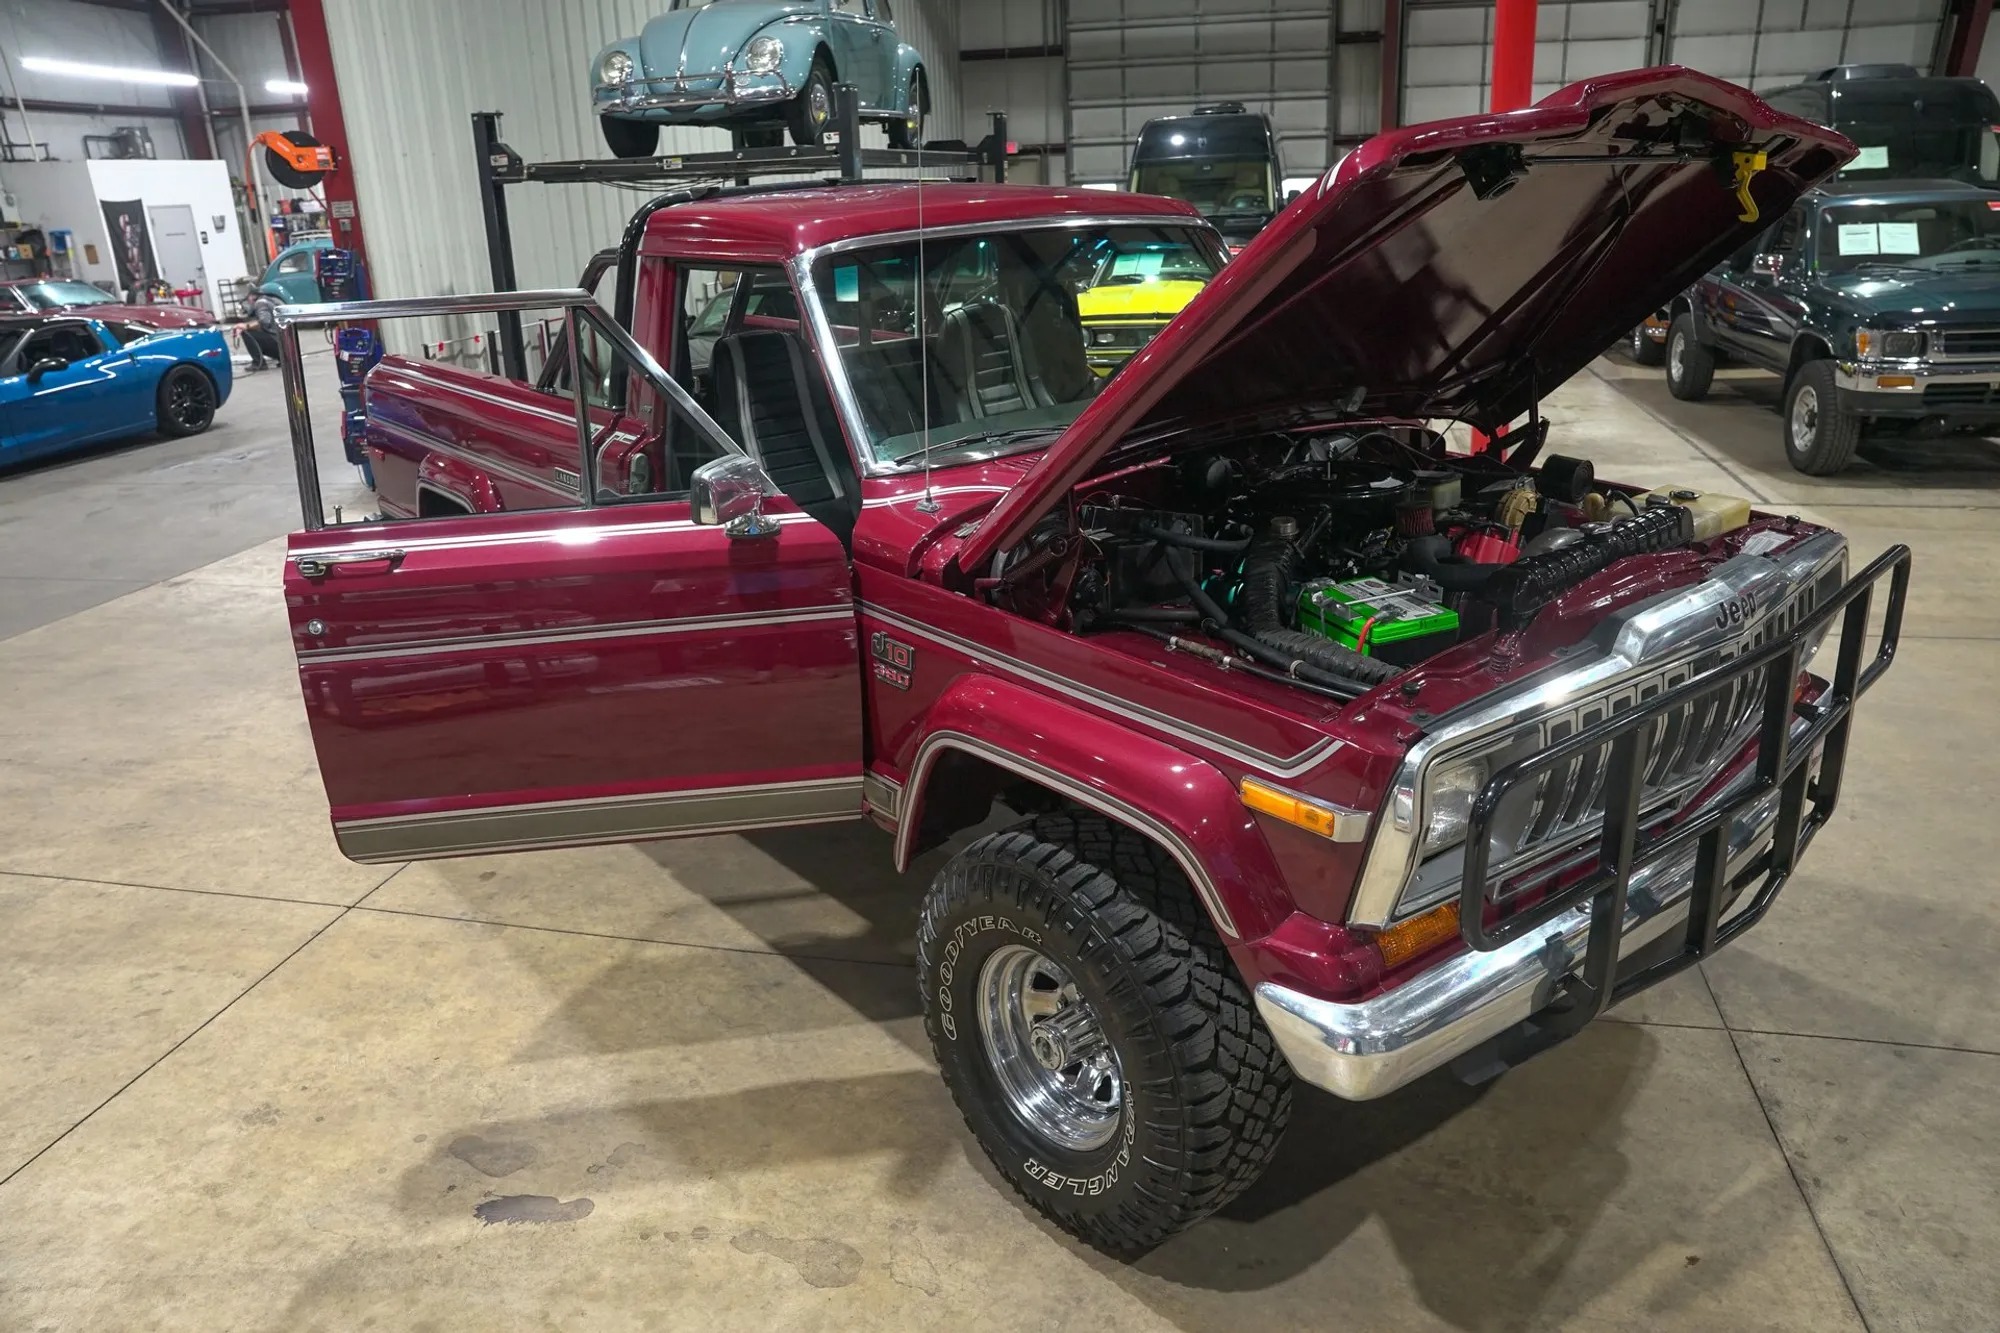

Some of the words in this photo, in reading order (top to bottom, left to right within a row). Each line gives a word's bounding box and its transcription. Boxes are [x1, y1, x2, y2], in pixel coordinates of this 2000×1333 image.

[1715, 592, 1756, 629] Jeep
[940, 916, 1042, 1041] GOODYEAR
[1023, 1080, 1135, 1195] WRANGLER
